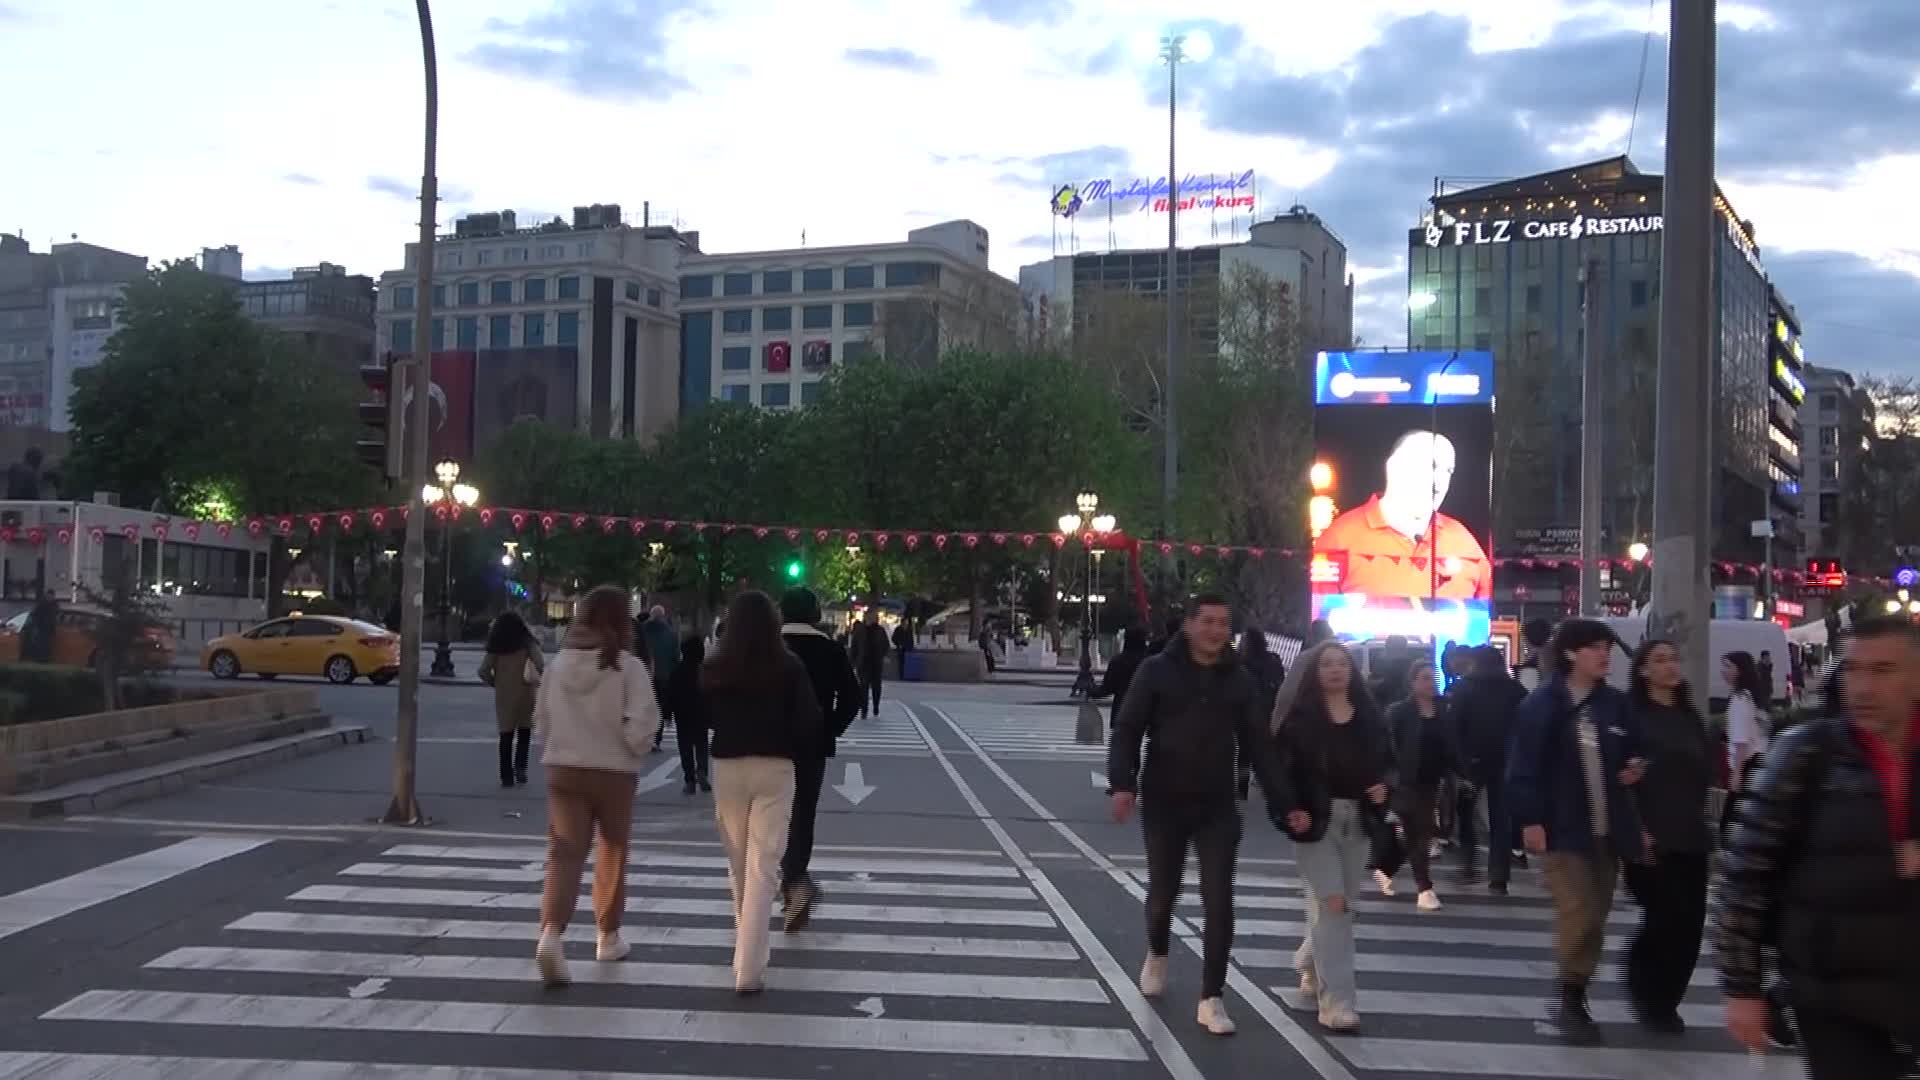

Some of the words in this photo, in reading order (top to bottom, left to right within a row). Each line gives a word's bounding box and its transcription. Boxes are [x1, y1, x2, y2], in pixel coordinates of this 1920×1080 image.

[1080, 177, 1171, 211] Mustafa
[1178, 168, 1254, 191] Kemal
[1454, 220, 1512, 245] FLZ
